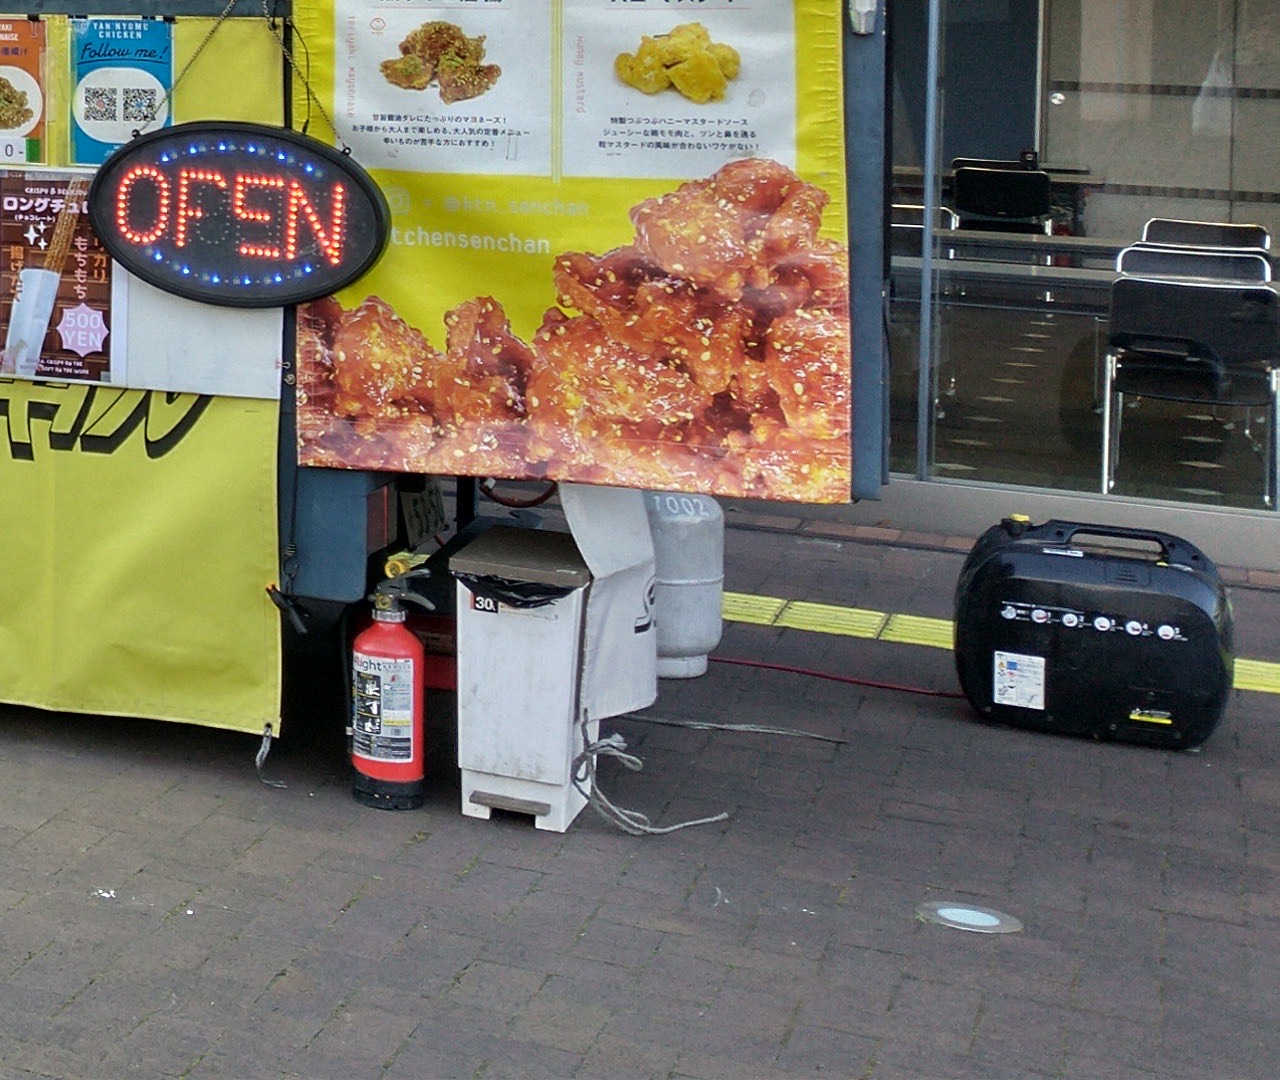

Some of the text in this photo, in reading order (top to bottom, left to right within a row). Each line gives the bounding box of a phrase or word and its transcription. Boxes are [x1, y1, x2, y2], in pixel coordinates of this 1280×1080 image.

[98, 30, 142, 39] CHICKEN
[80, 42, 132, 60] Follow
[3, 197, 89, 215] ロングチュ
[74, 236, 88, 299] もちもち
[65, 313, 100, 329] 500
[64, 331, 101, 347] YEN
